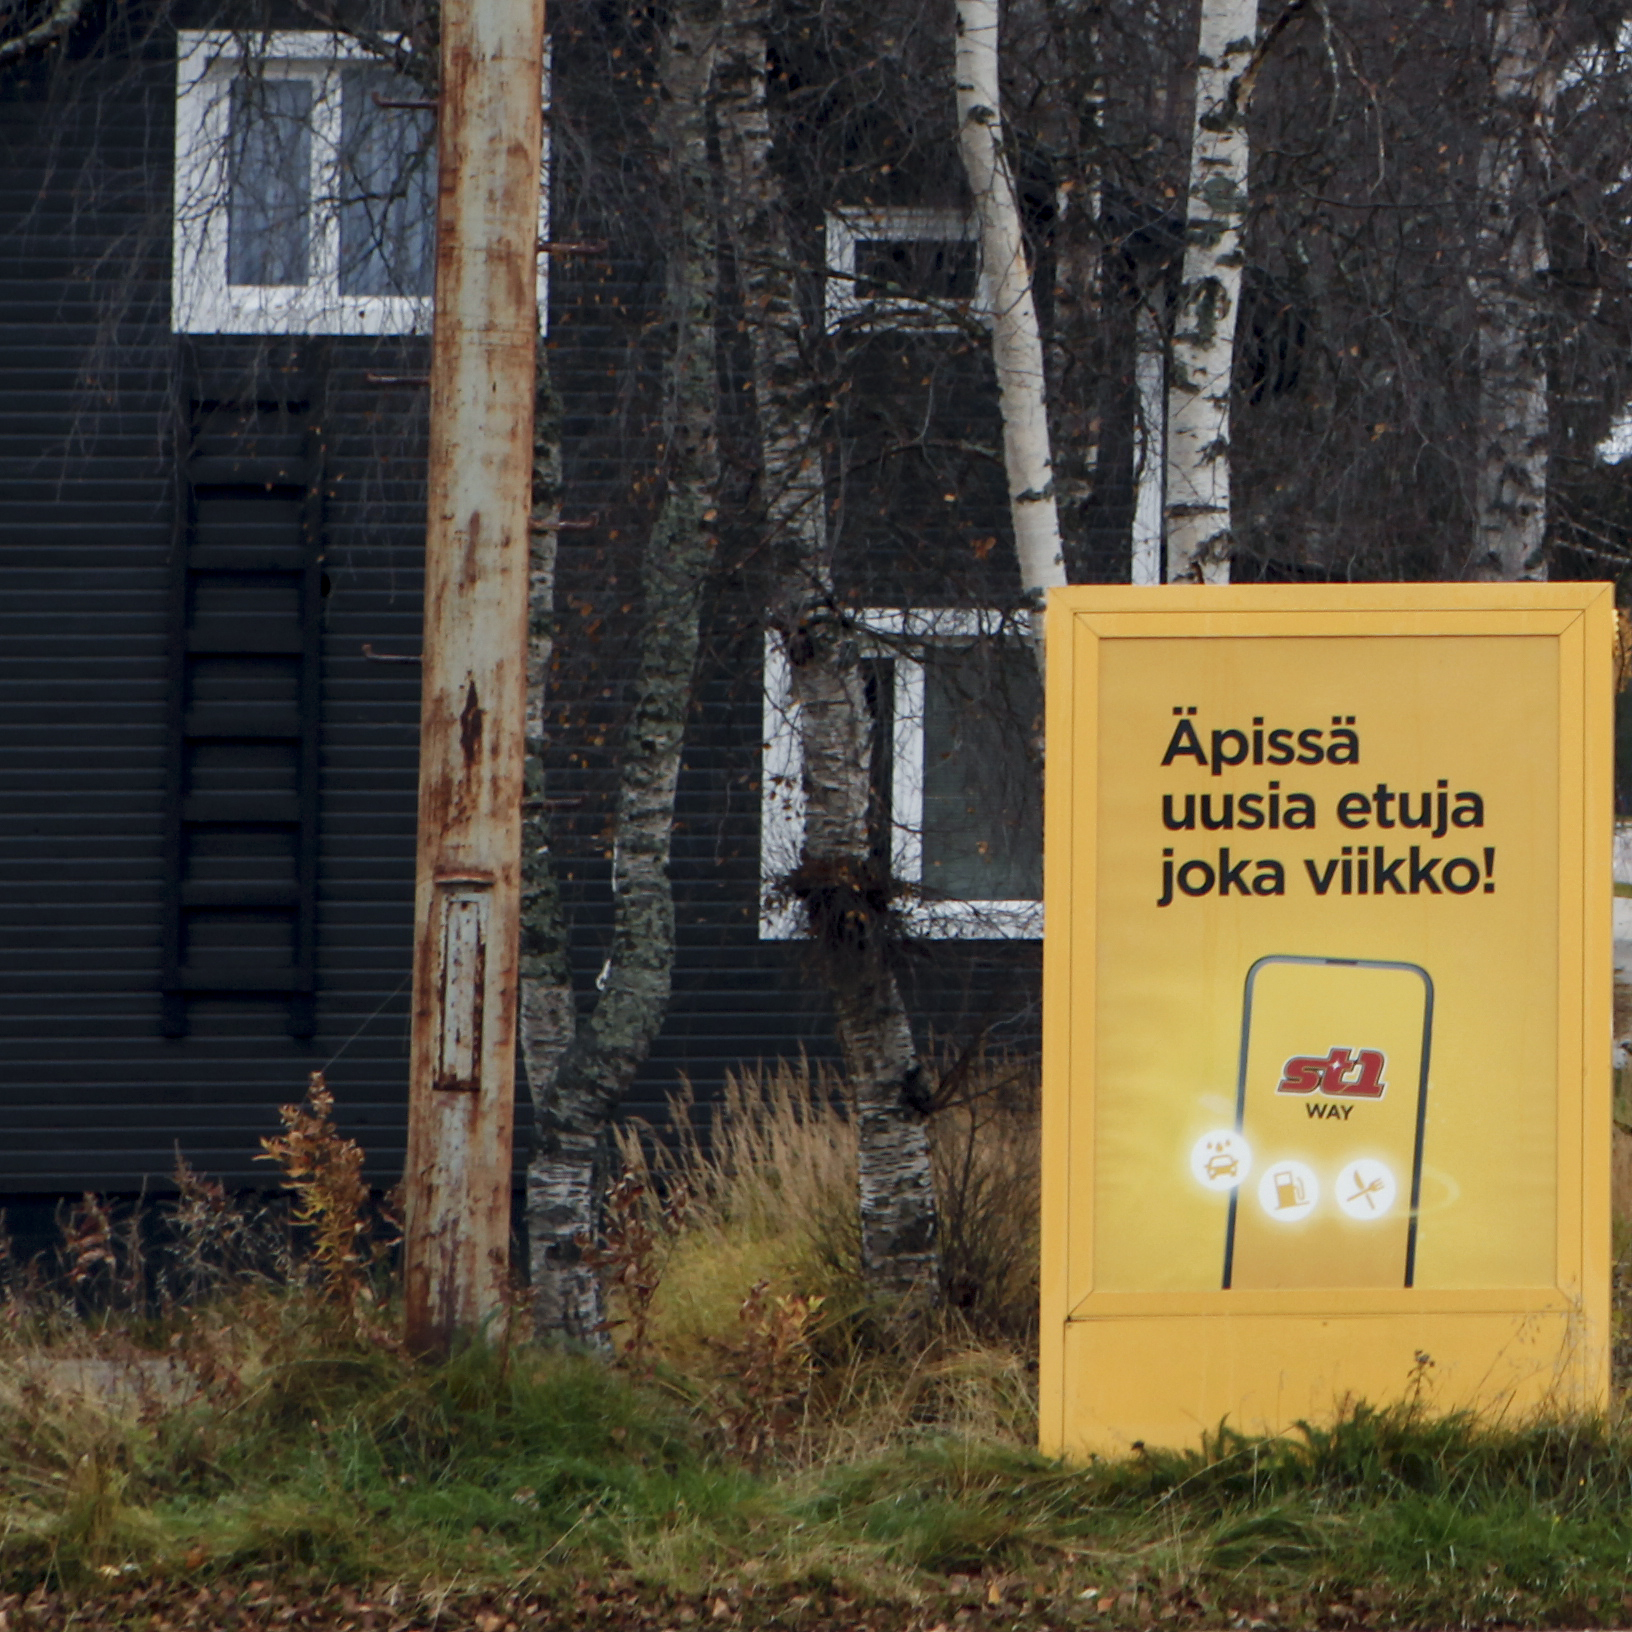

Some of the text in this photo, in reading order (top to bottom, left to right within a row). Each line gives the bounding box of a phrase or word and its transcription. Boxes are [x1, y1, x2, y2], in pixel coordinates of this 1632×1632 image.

[1159, 705, 1361, 777] Äpissä
[1161, 778, 1485, 839] uusia etuja
[1156, 845, 1497, 908] joka viikko!
[1305, 1102, 1355, 1121] WAY
